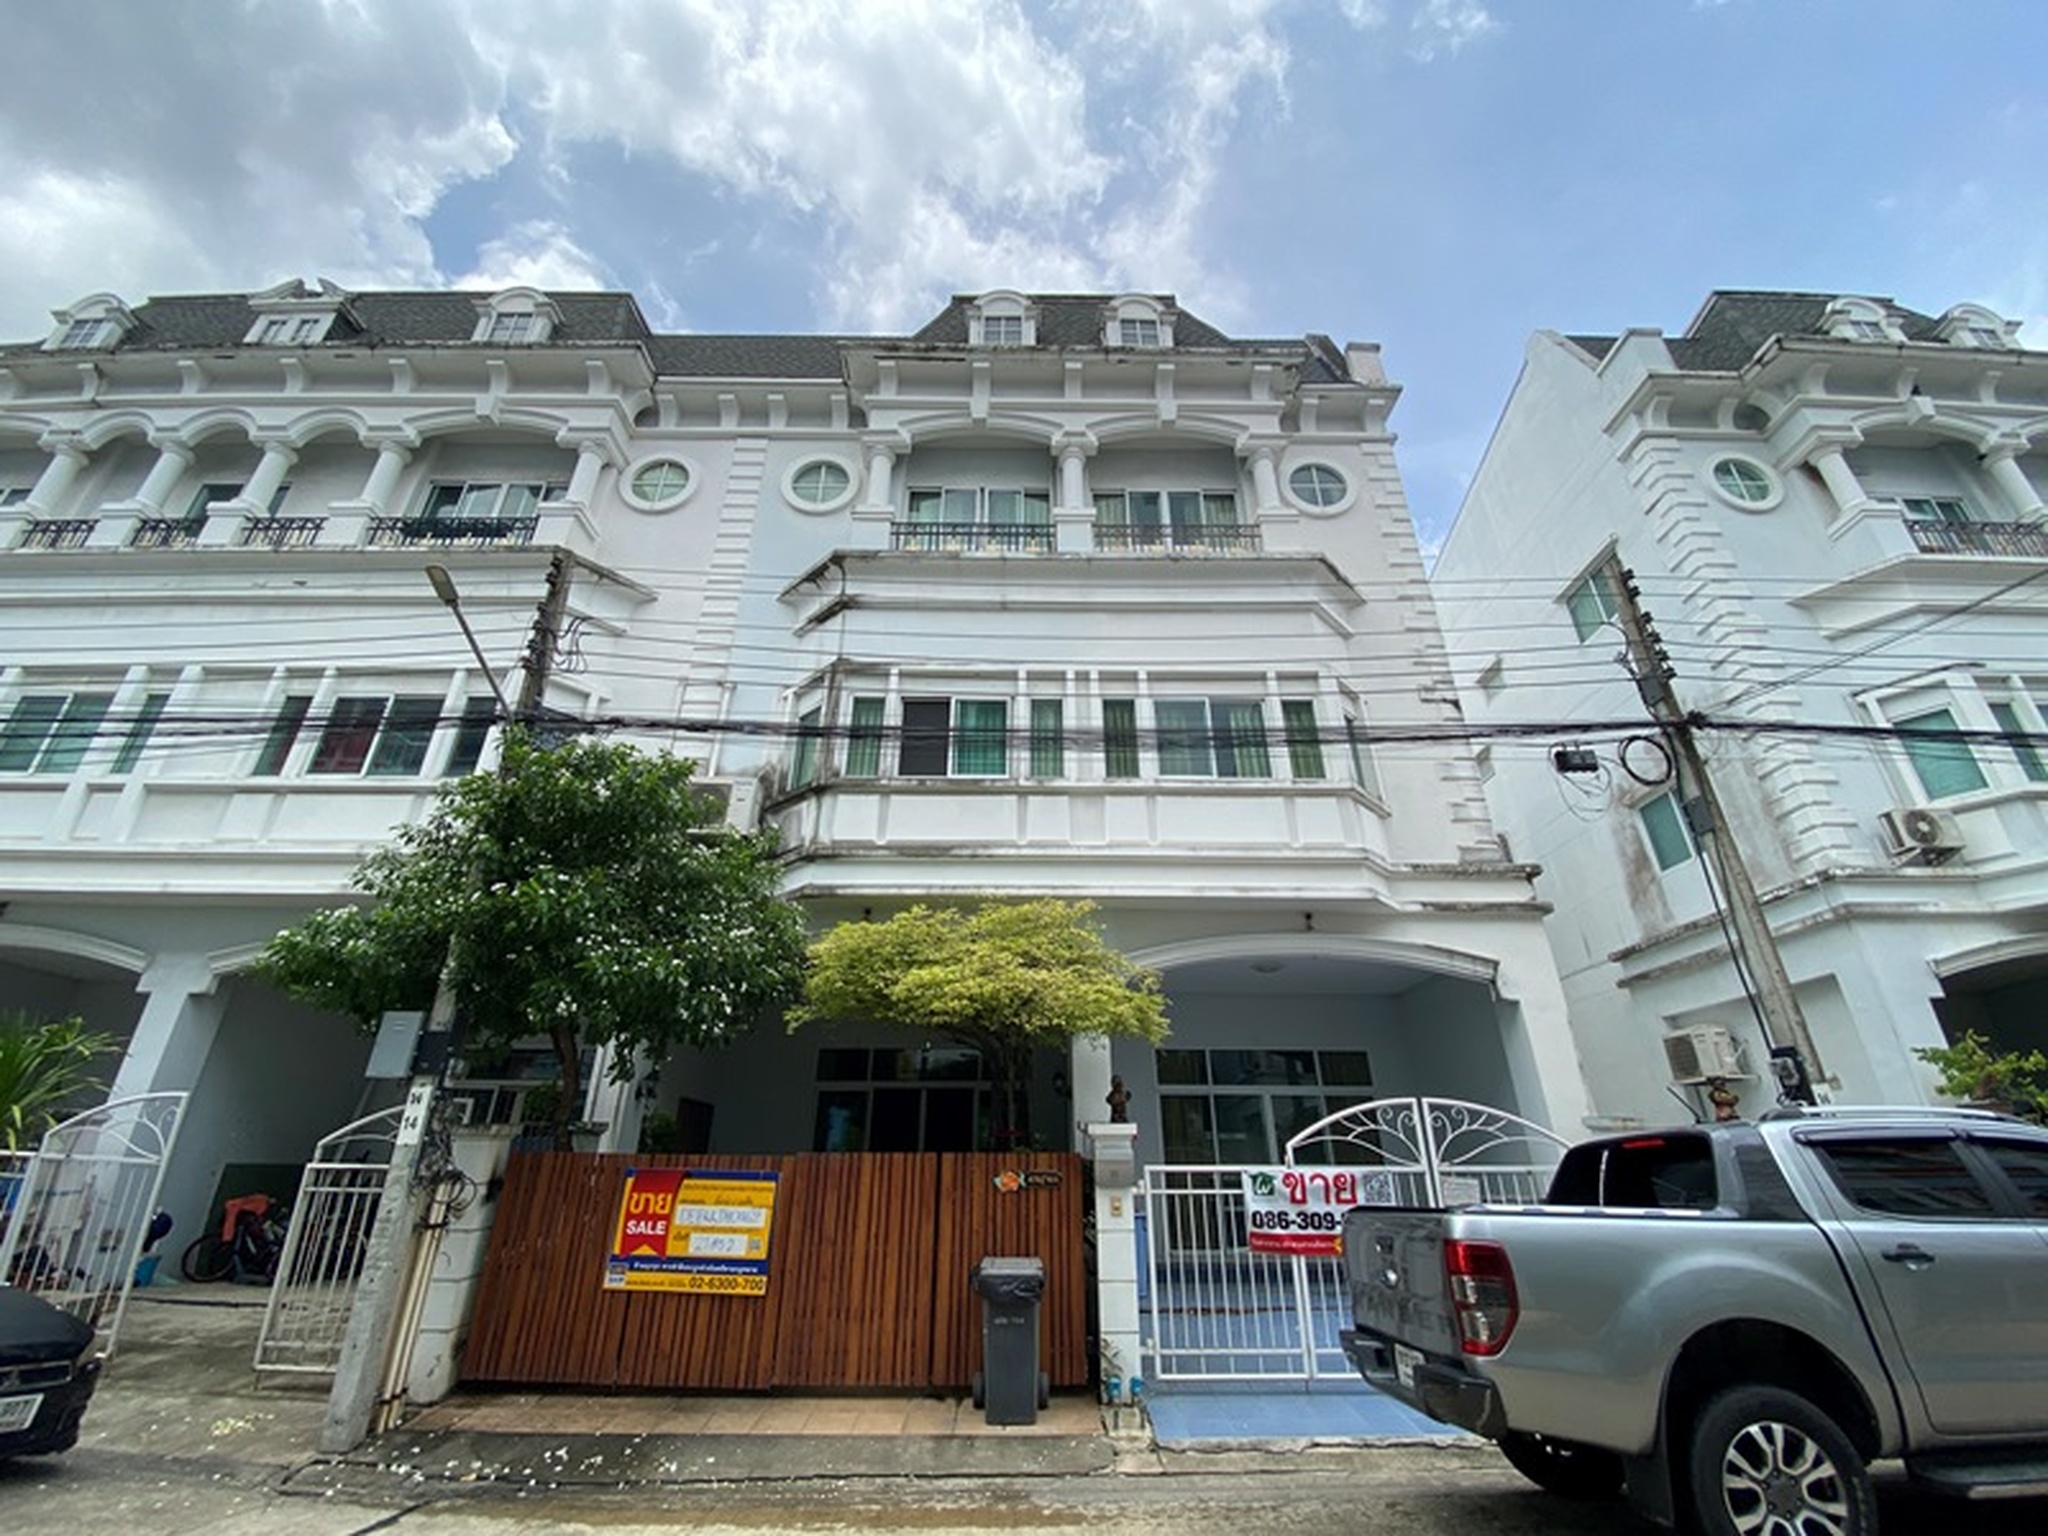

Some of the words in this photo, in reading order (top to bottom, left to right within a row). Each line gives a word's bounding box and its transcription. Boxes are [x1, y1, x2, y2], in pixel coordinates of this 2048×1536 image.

[1281, 1171, 1358, 1205] ขาย
[629, 1192, 673, 1215] ขาย
[626, 1220, 667, 1235] SALE
[1251, 1210, 1347, 1231] 086-309-
[688, 1276, 764, 1291] 02-6300-700
